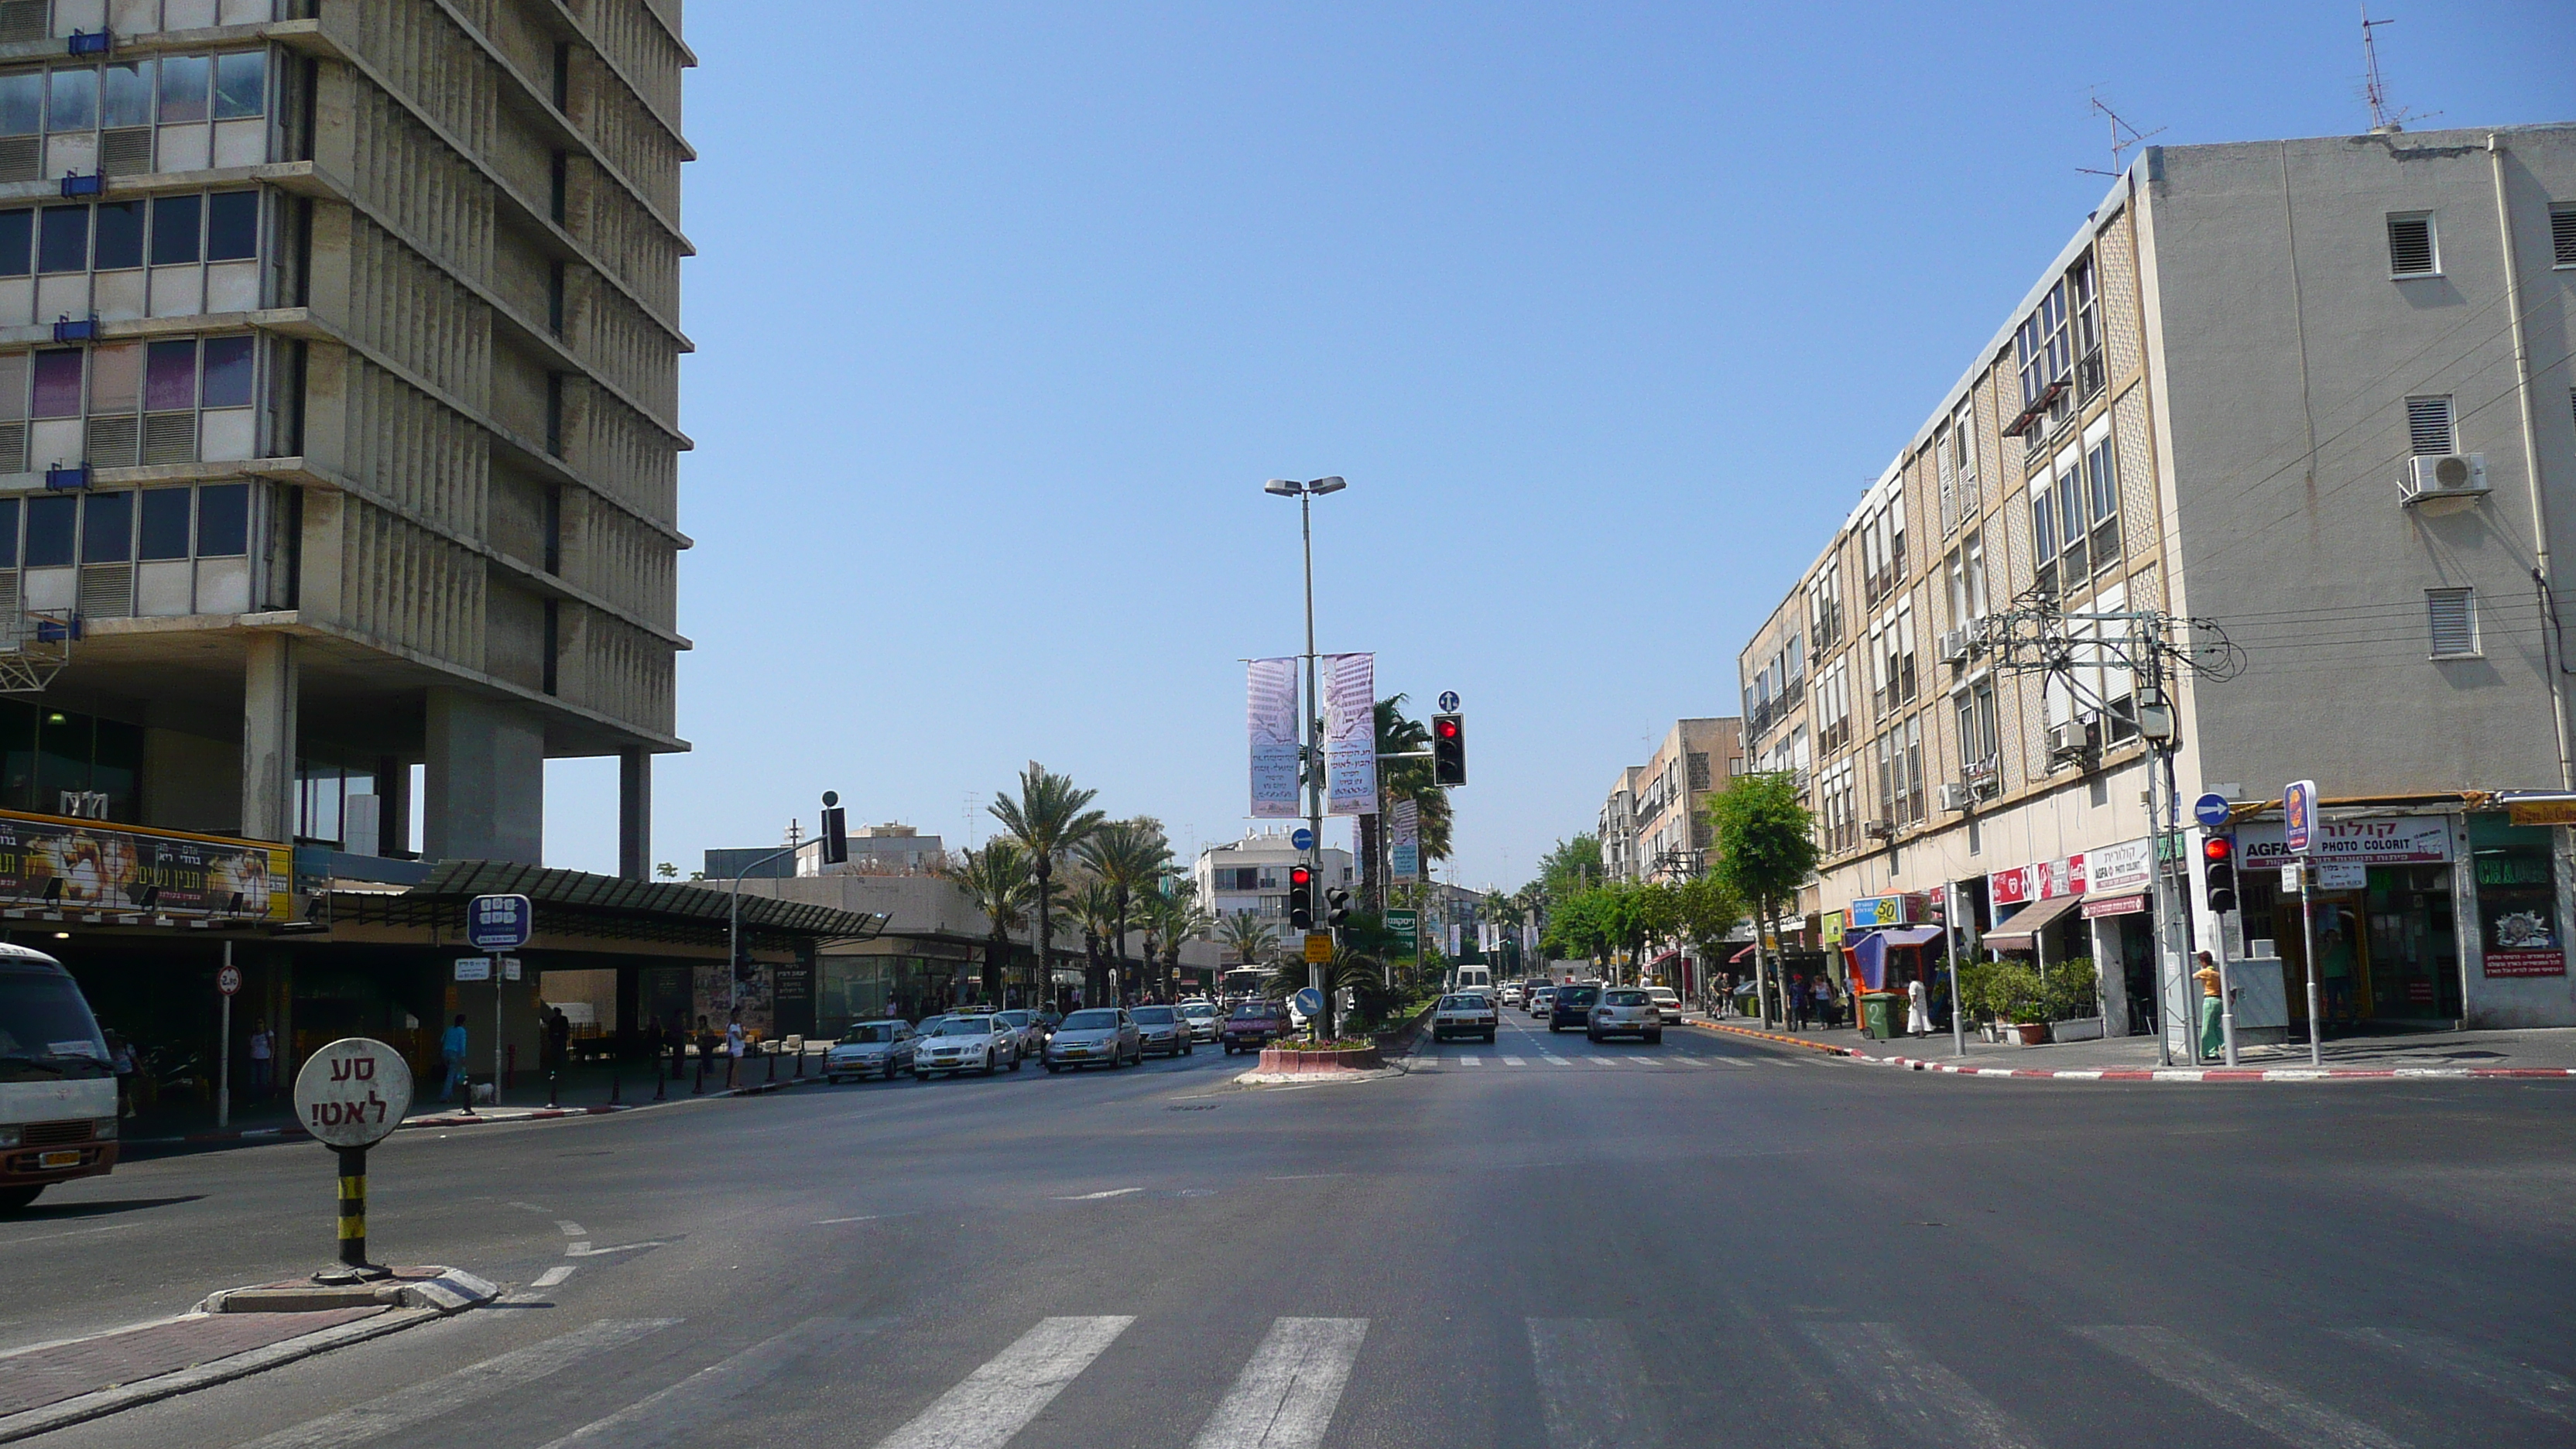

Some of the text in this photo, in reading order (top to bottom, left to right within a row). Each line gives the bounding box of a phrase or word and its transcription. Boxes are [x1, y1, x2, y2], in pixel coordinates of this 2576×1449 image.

[2319, 820, 2397, 838] קולור
[2246, 838, 2410, 857] AGFA PHOTO COLORIT
[2095, 866, 2108, 879] AGFA
[1878, 902, 1895, 917] 50
[1387, 917, 1416, 927] דיסקונט
[1869, 1004, 1882, 1025] 2
[331, 1057, 375, 1081] סע
[311, 1090, 387, 1127] לאט!
